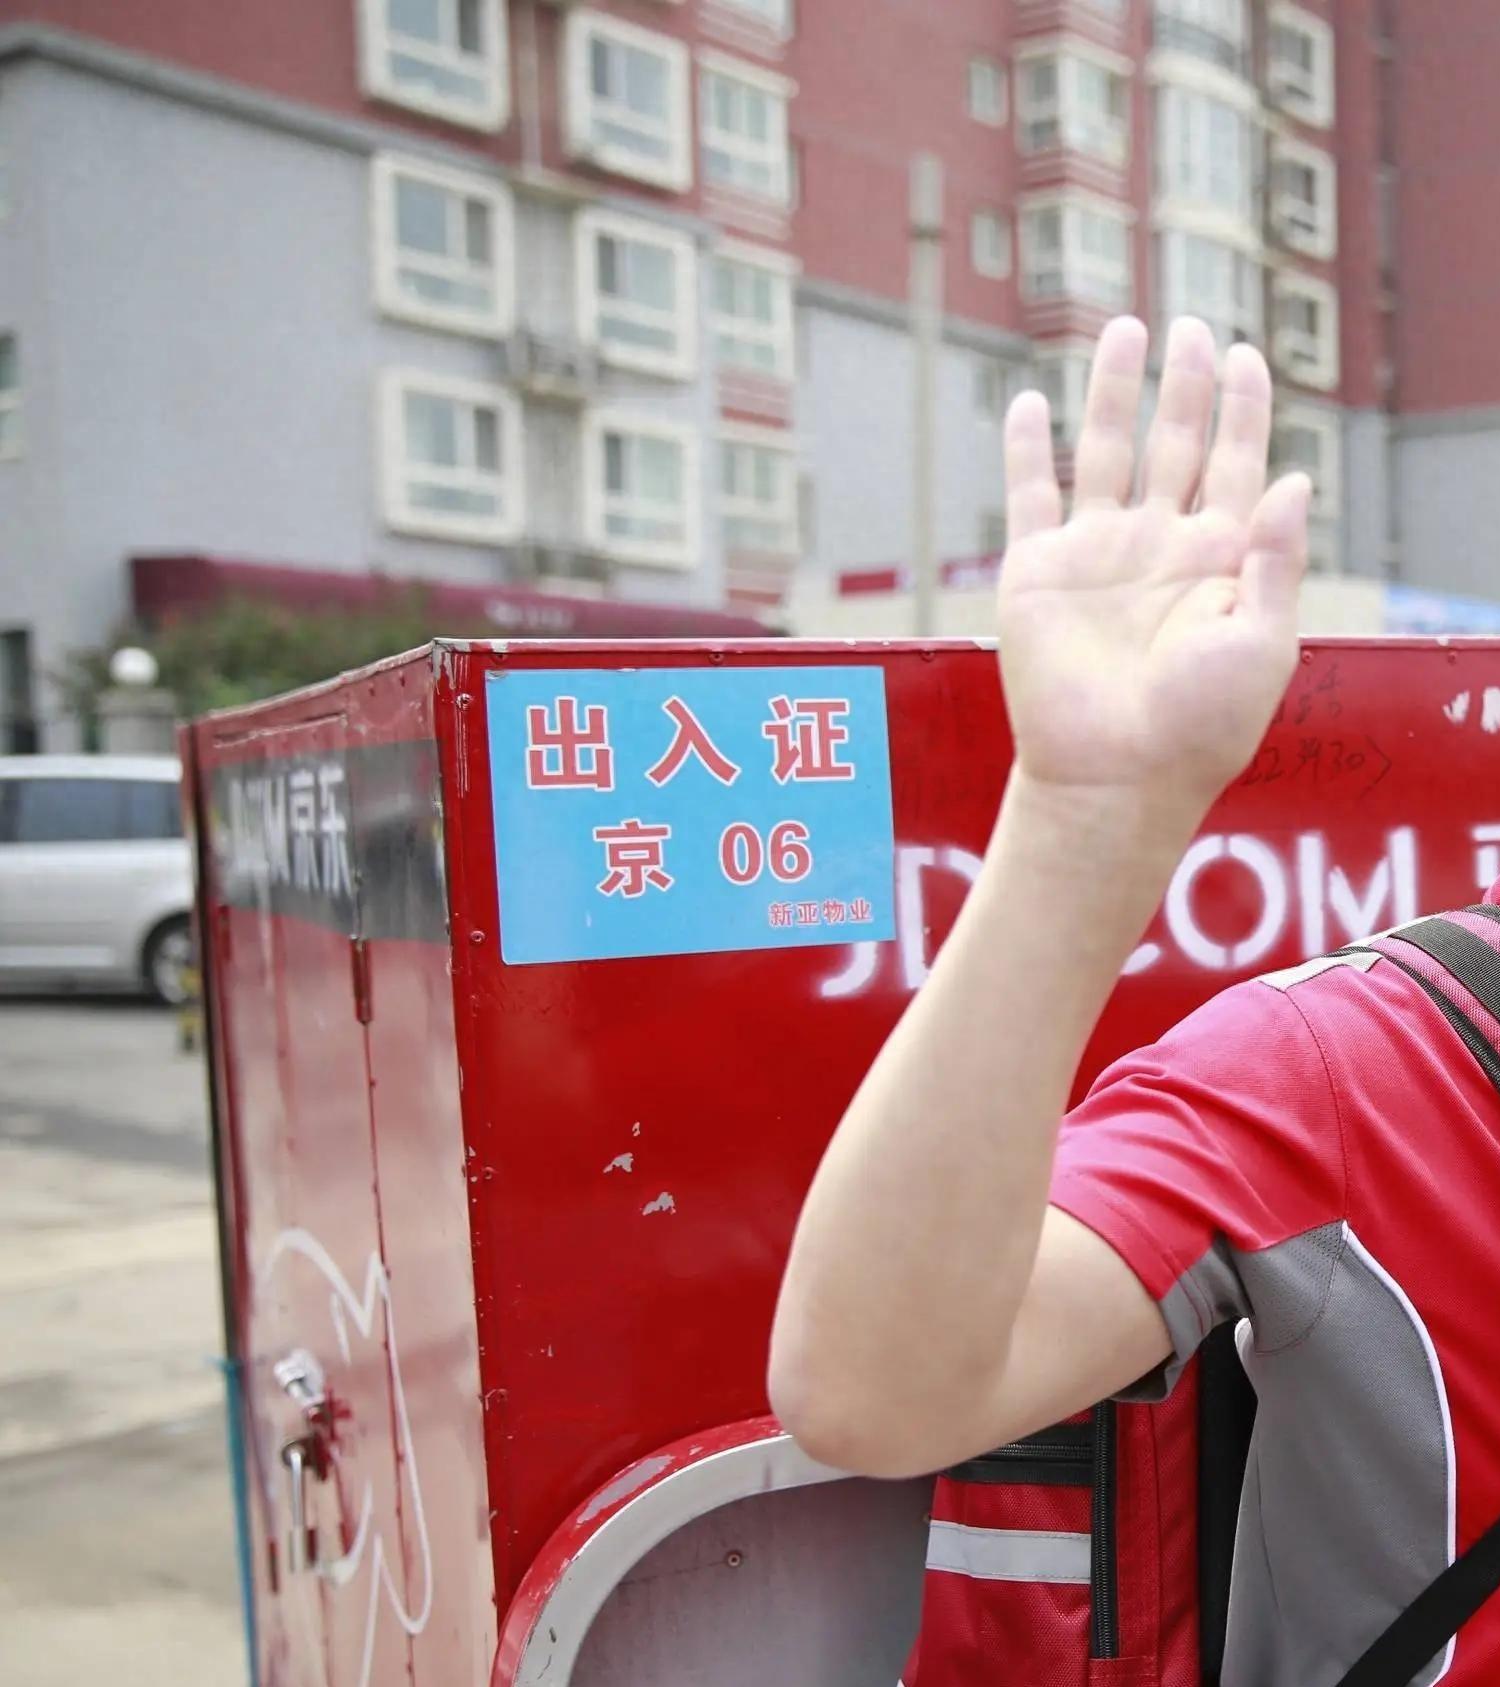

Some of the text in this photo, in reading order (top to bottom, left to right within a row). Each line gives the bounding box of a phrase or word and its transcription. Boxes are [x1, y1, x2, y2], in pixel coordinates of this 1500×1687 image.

[526, 694, 856, 792] 出入证
[592, 817, 814, 899] 京 06
[768, 898, 875, 928] 新亚物业
